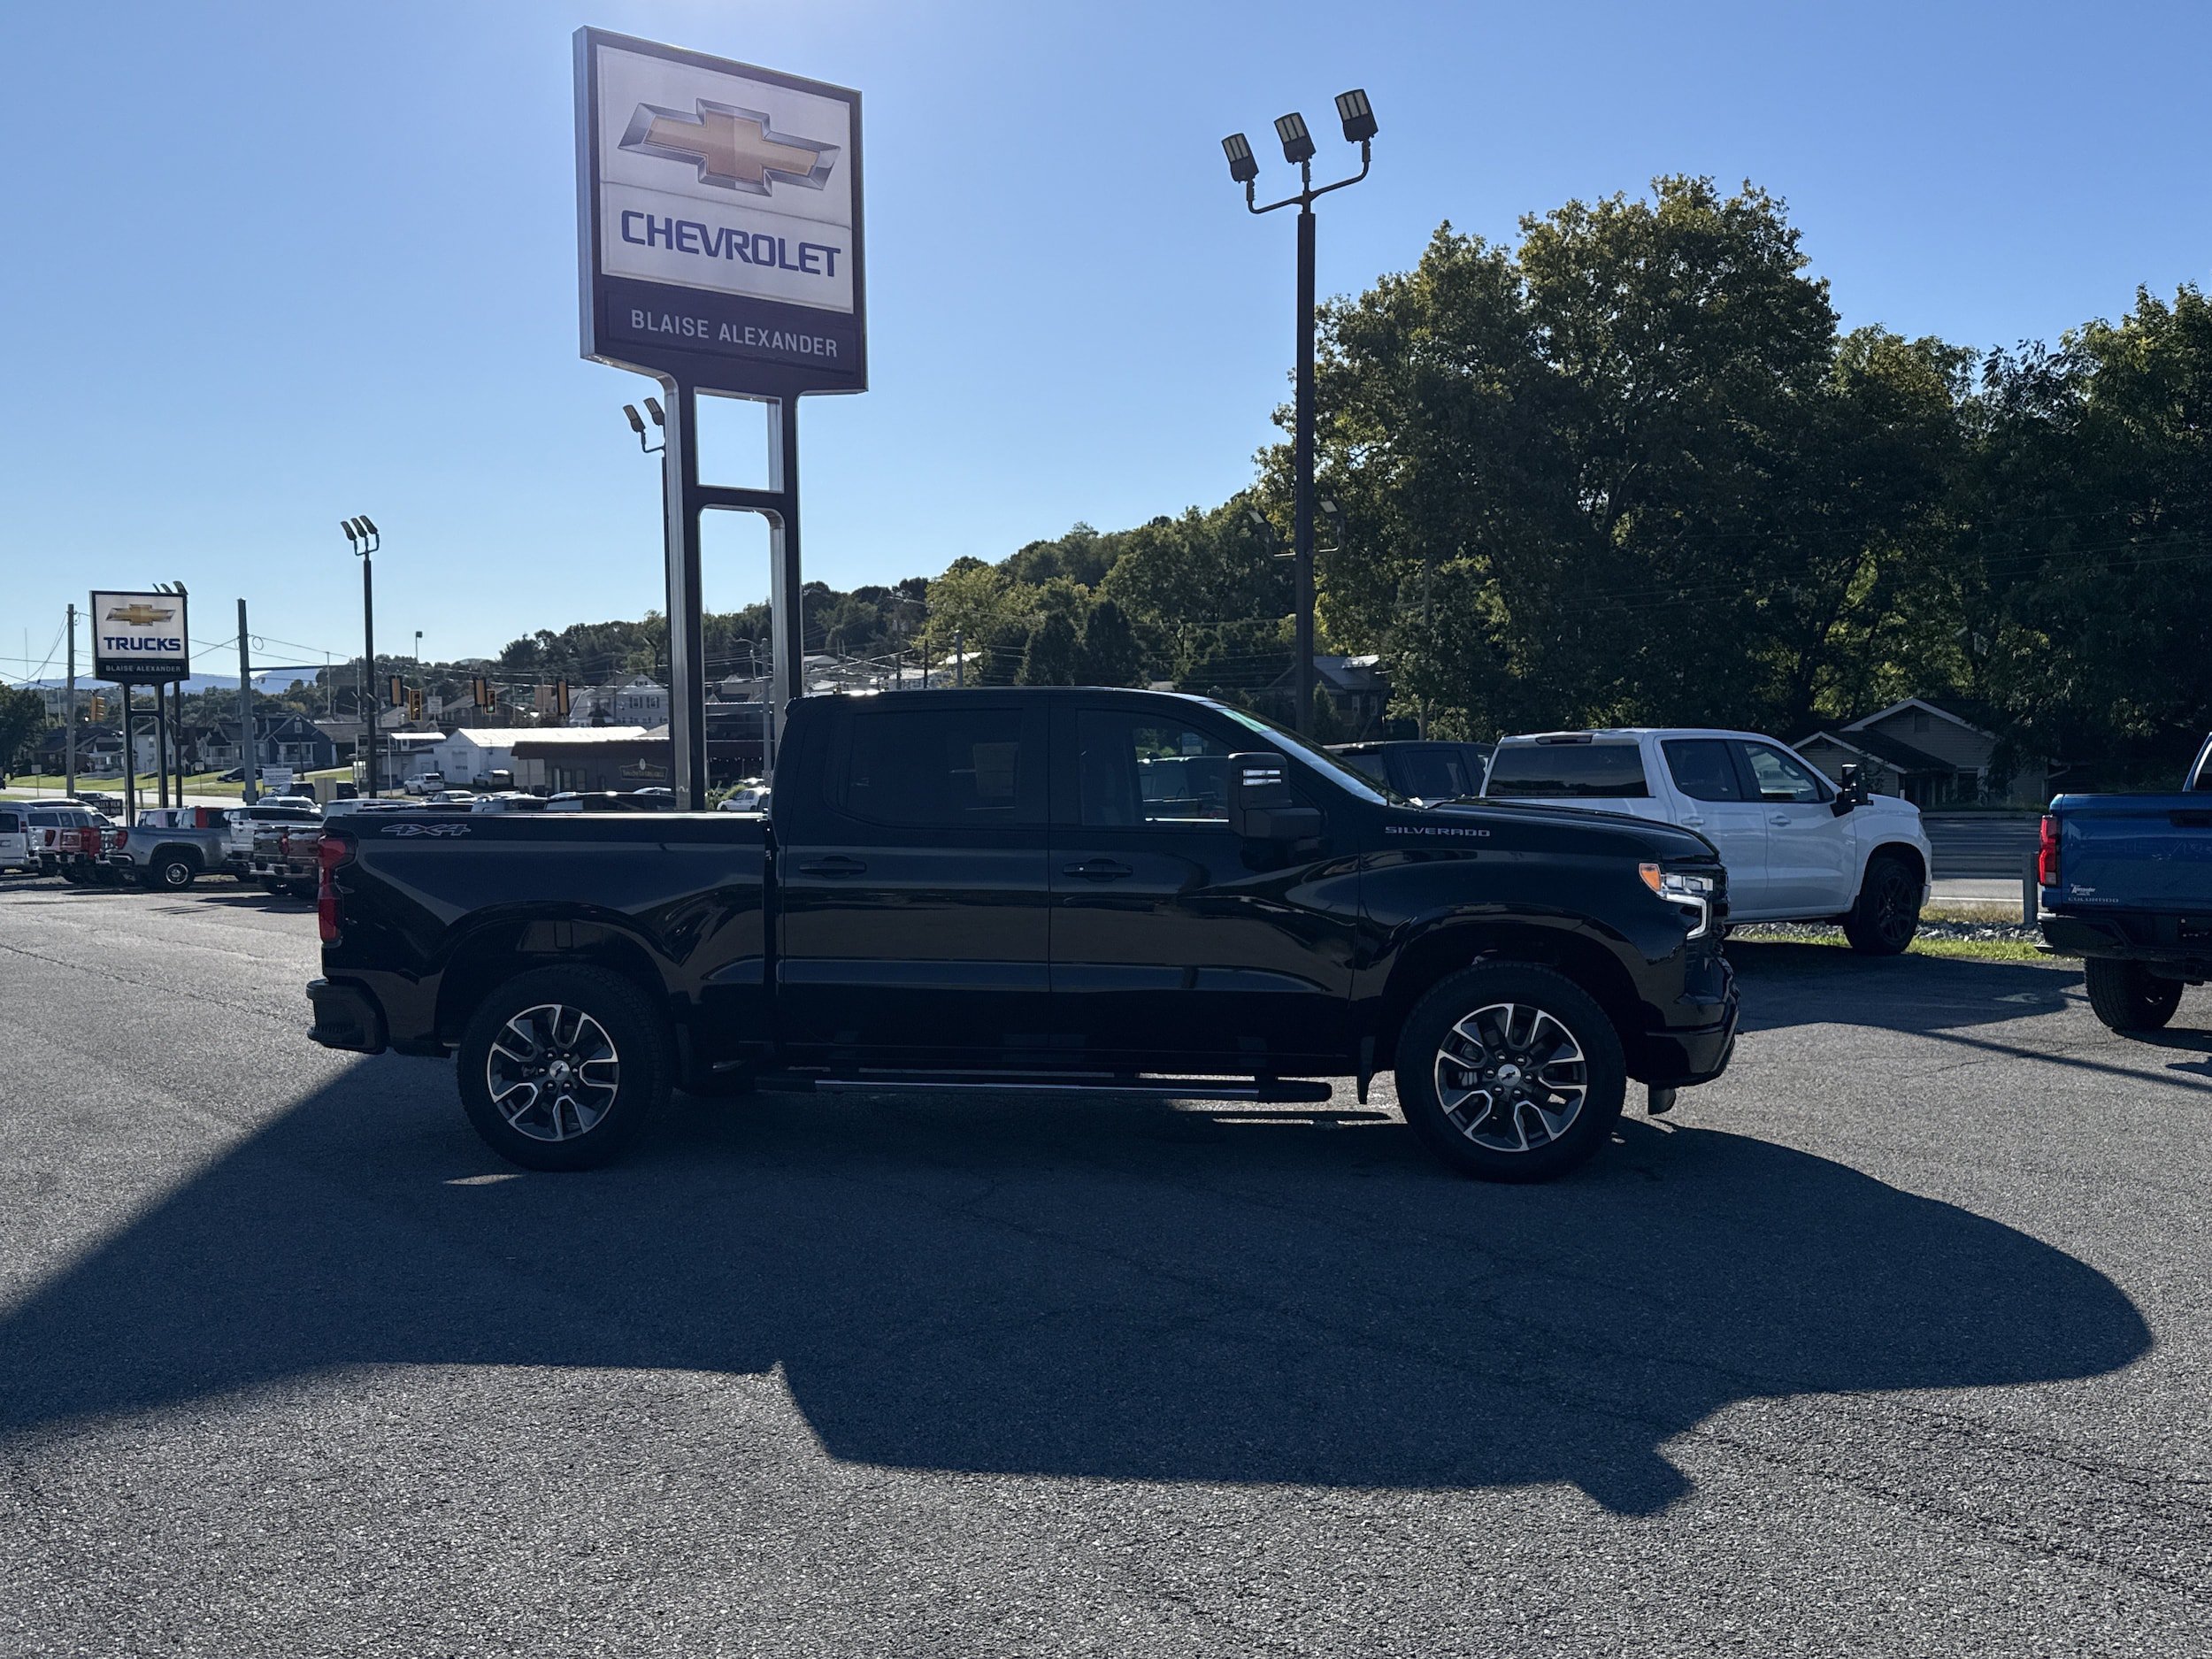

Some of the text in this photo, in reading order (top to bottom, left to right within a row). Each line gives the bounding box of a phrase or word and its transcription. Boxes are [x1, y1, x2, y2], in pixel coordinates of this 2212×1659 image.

[621, 210, 841, 277] CHEVROLET
[631, 309, 838, 357] BLAISE ALEXANDER
[104, 637, 181, 651] TRUCKS
[1385, 826, 1491, 837] SILVERADO
